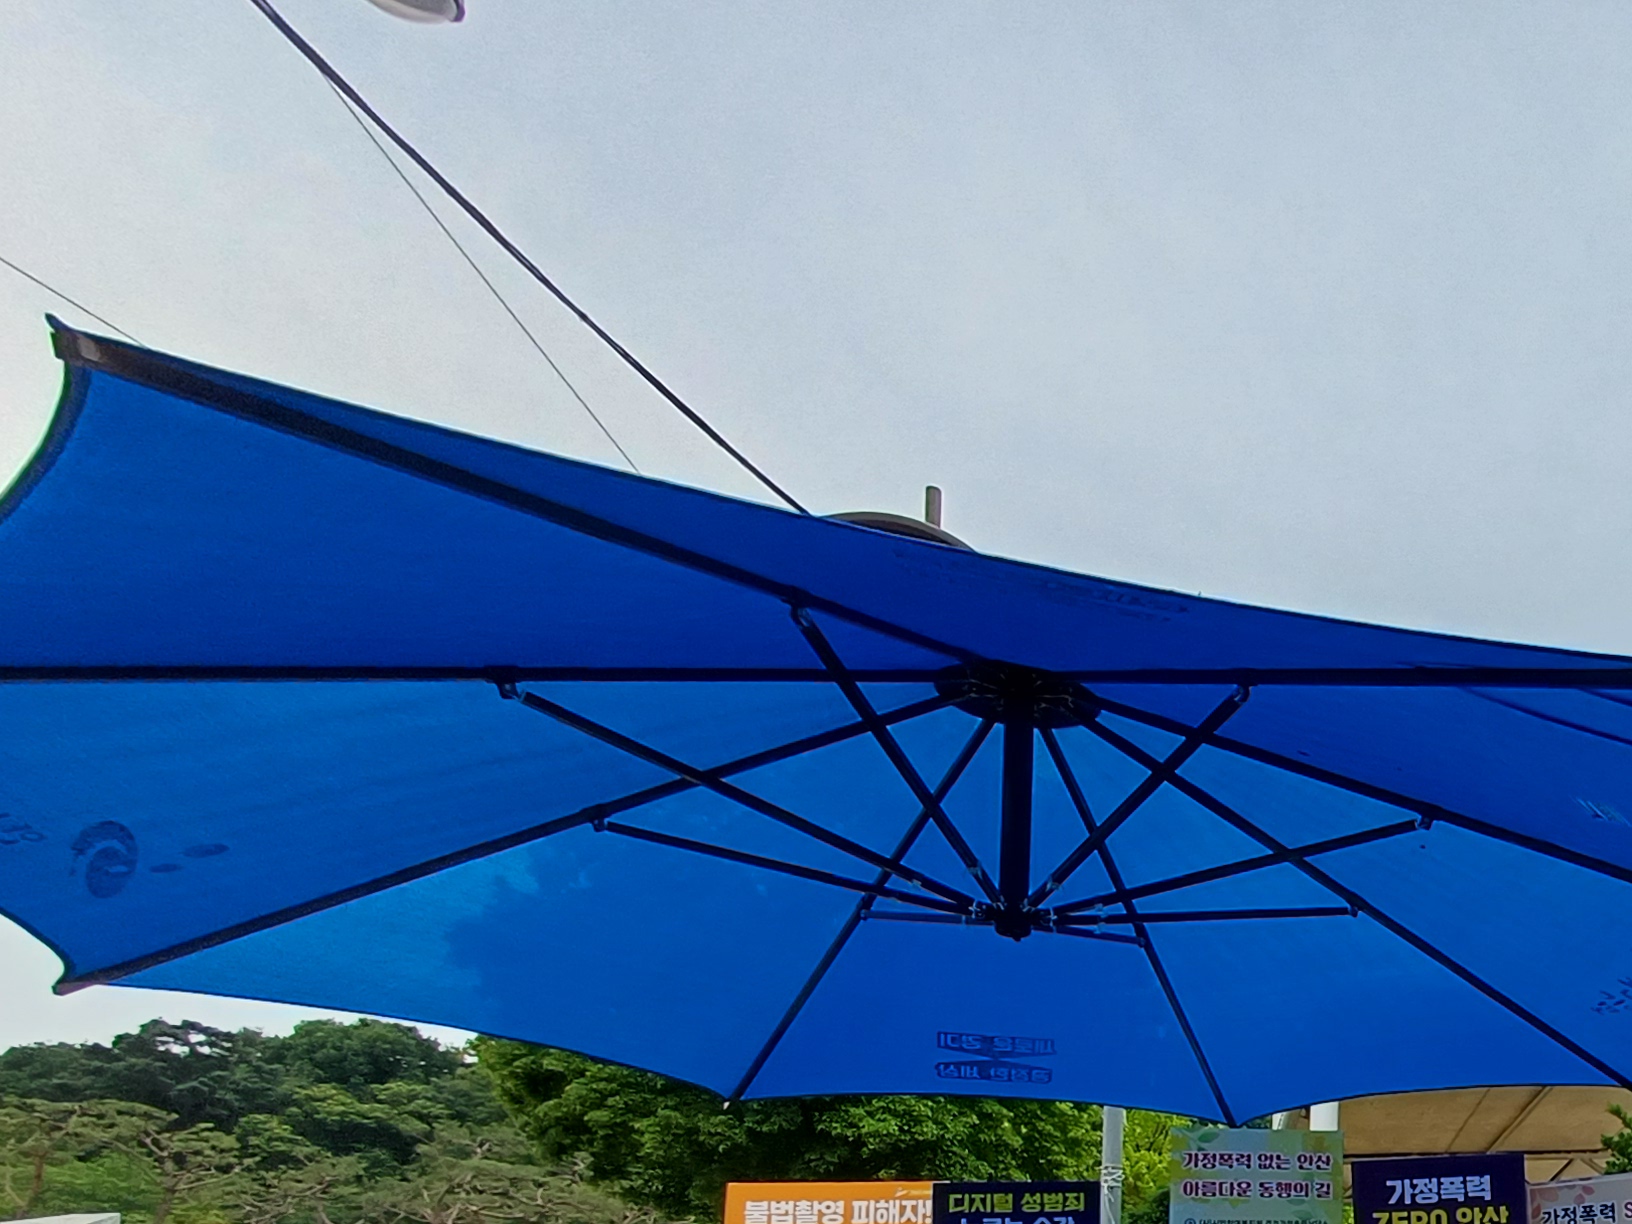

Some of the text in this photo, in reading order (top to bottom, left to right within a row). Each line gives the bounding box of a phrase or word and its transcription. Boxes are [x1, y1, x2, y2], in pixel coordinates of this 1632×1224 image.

[1183, 1152, 1332, 1170] 가정폭력 없는 안산
[1183, 1181, 1331, 1198] 아름다운 동행의 길
[1386, 1175, 1492, 1205] 가정폭력
[948, 1192, 1086, 1214] 디지털 성범죄
